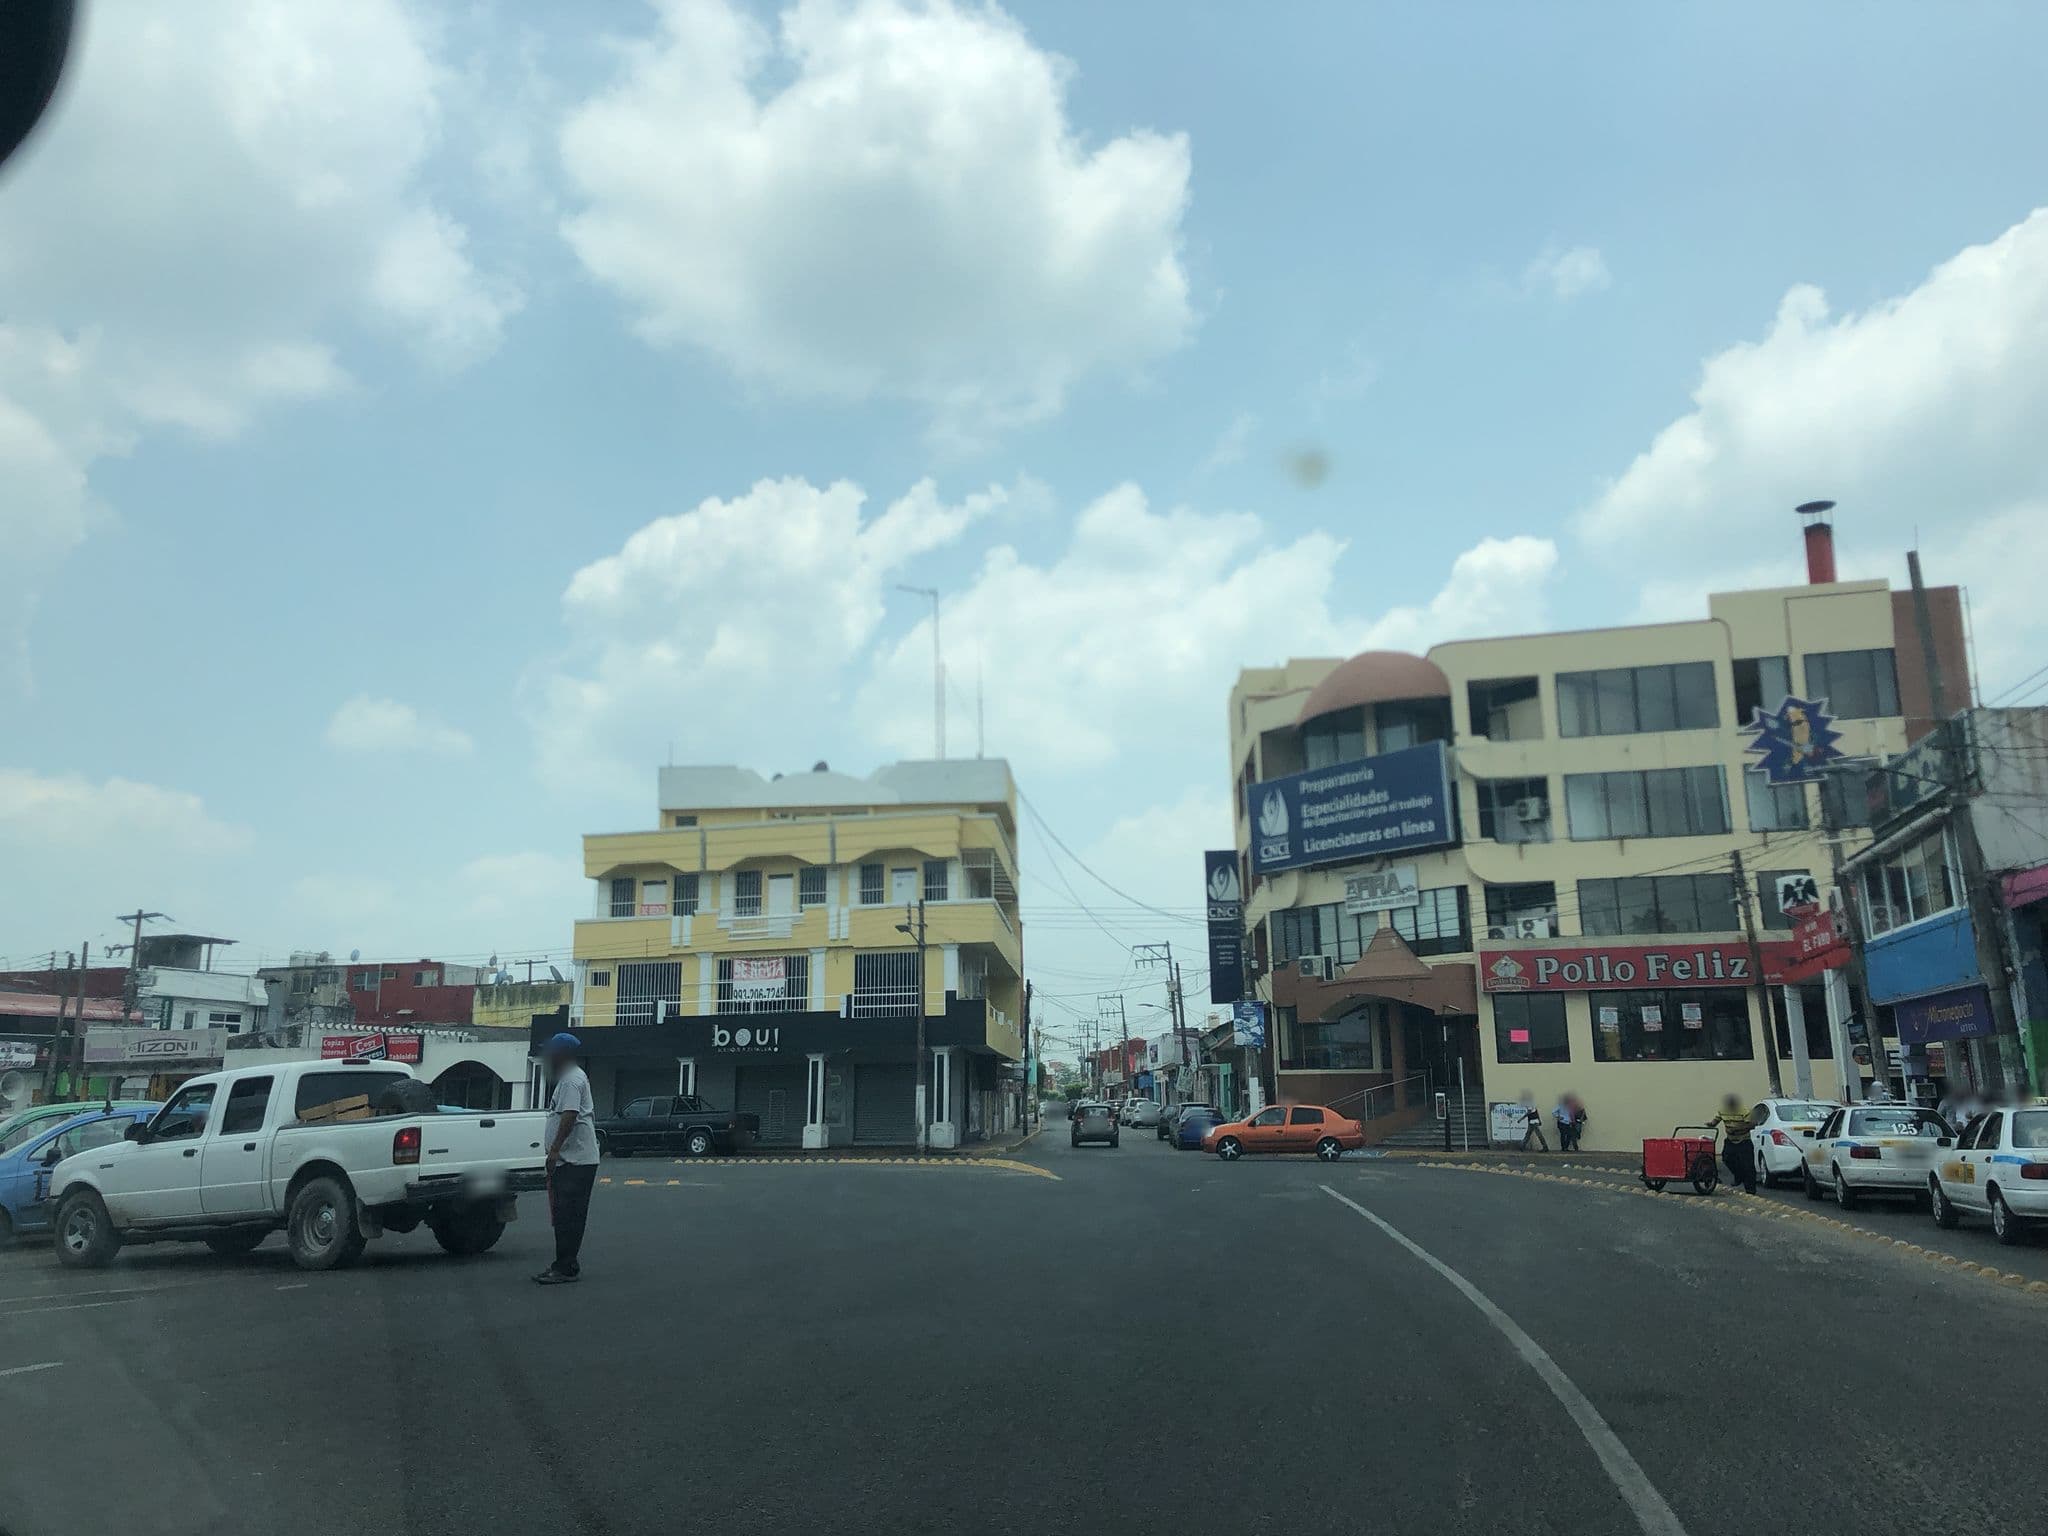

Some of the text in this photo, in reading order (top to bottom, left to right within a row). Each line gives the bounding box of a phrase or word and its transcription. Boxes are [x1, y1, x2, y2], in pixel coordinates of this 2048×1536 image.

[1299, 767, 1375, 794] Preparatoria
[1301, 789, 1389, 818] Especialidades
[1303, 829, 1383, 853] Licenciaturas
[1383, 825, 1401, 839] en
[1535, 950, 1750, 984] Pollo Feliz
[1891, 1122, 1918, 1136] 125
